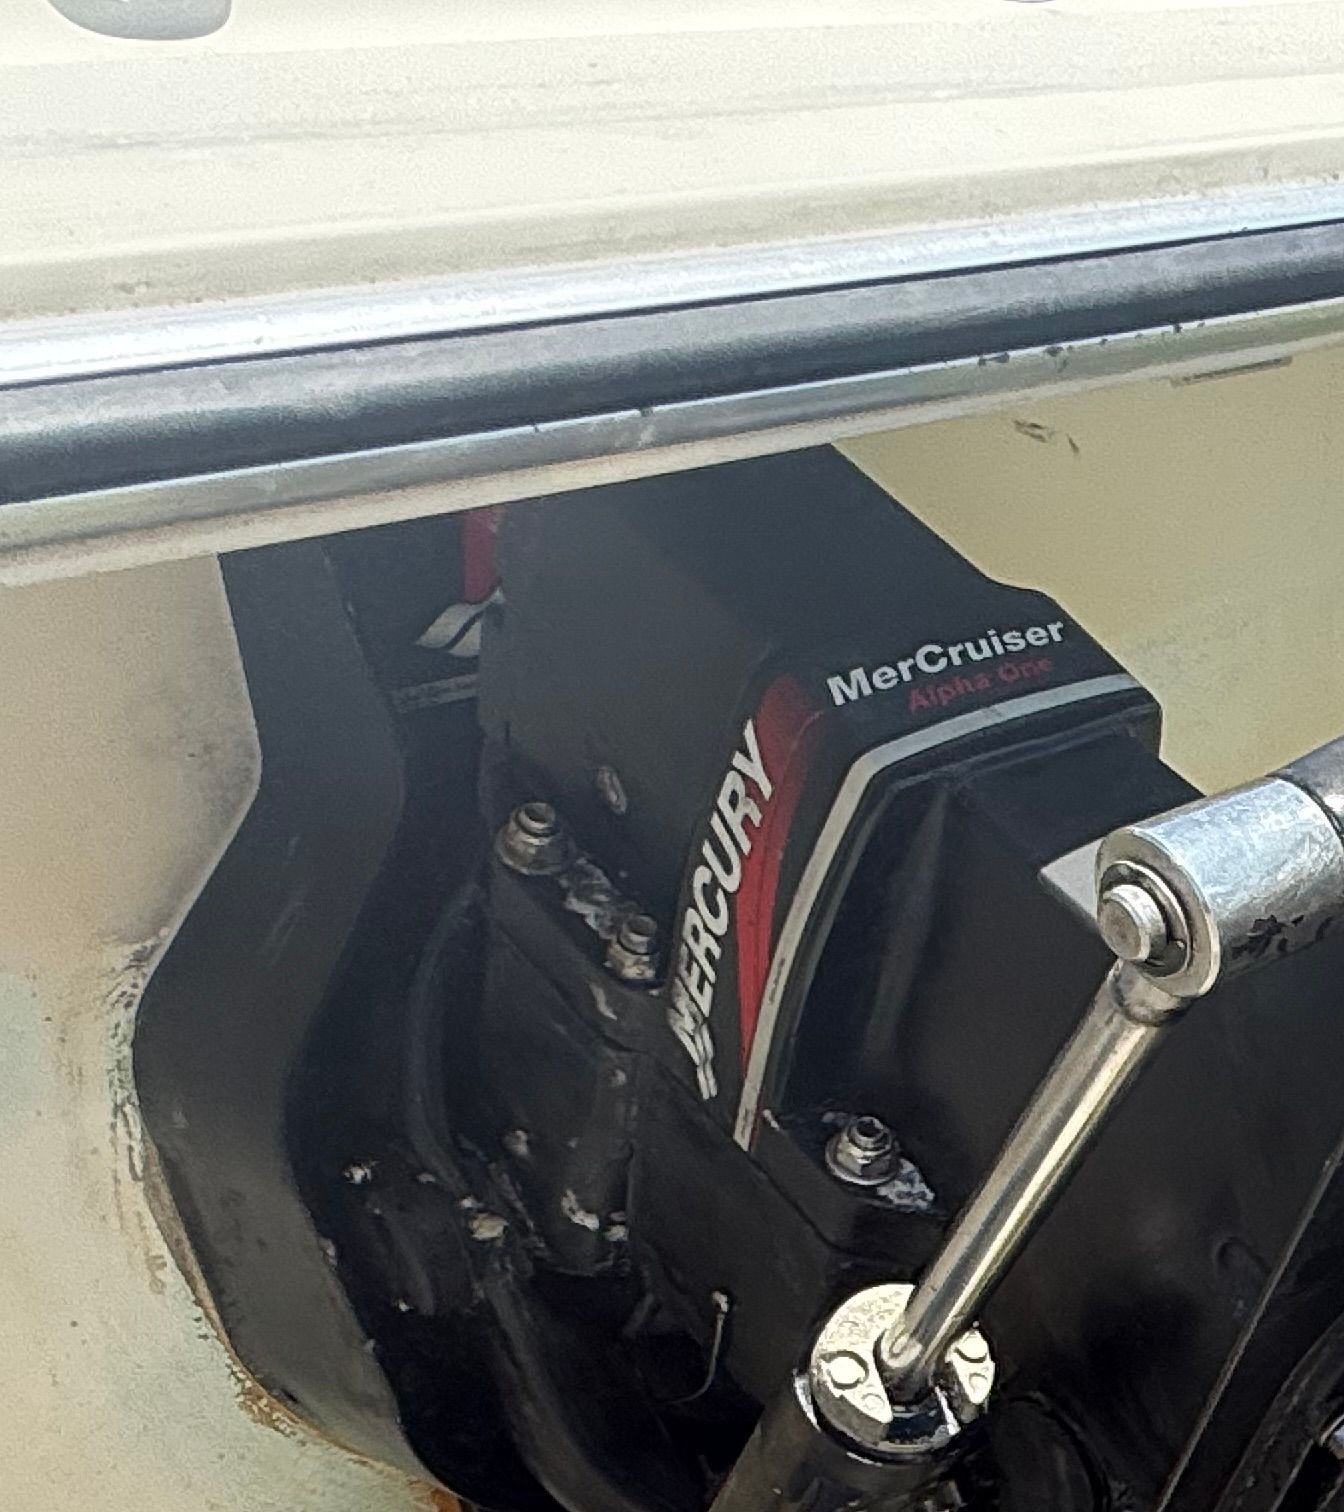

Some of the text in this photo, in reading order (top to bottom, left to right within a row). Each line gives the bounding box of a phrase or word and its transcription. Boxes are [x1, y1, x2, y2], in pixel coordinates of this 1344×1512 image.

[827, 620, 1064, 706] MerCruiser
[909, 657, 1051, 712] Alpha One
[667, 718, 773, 1098] MERCURY
